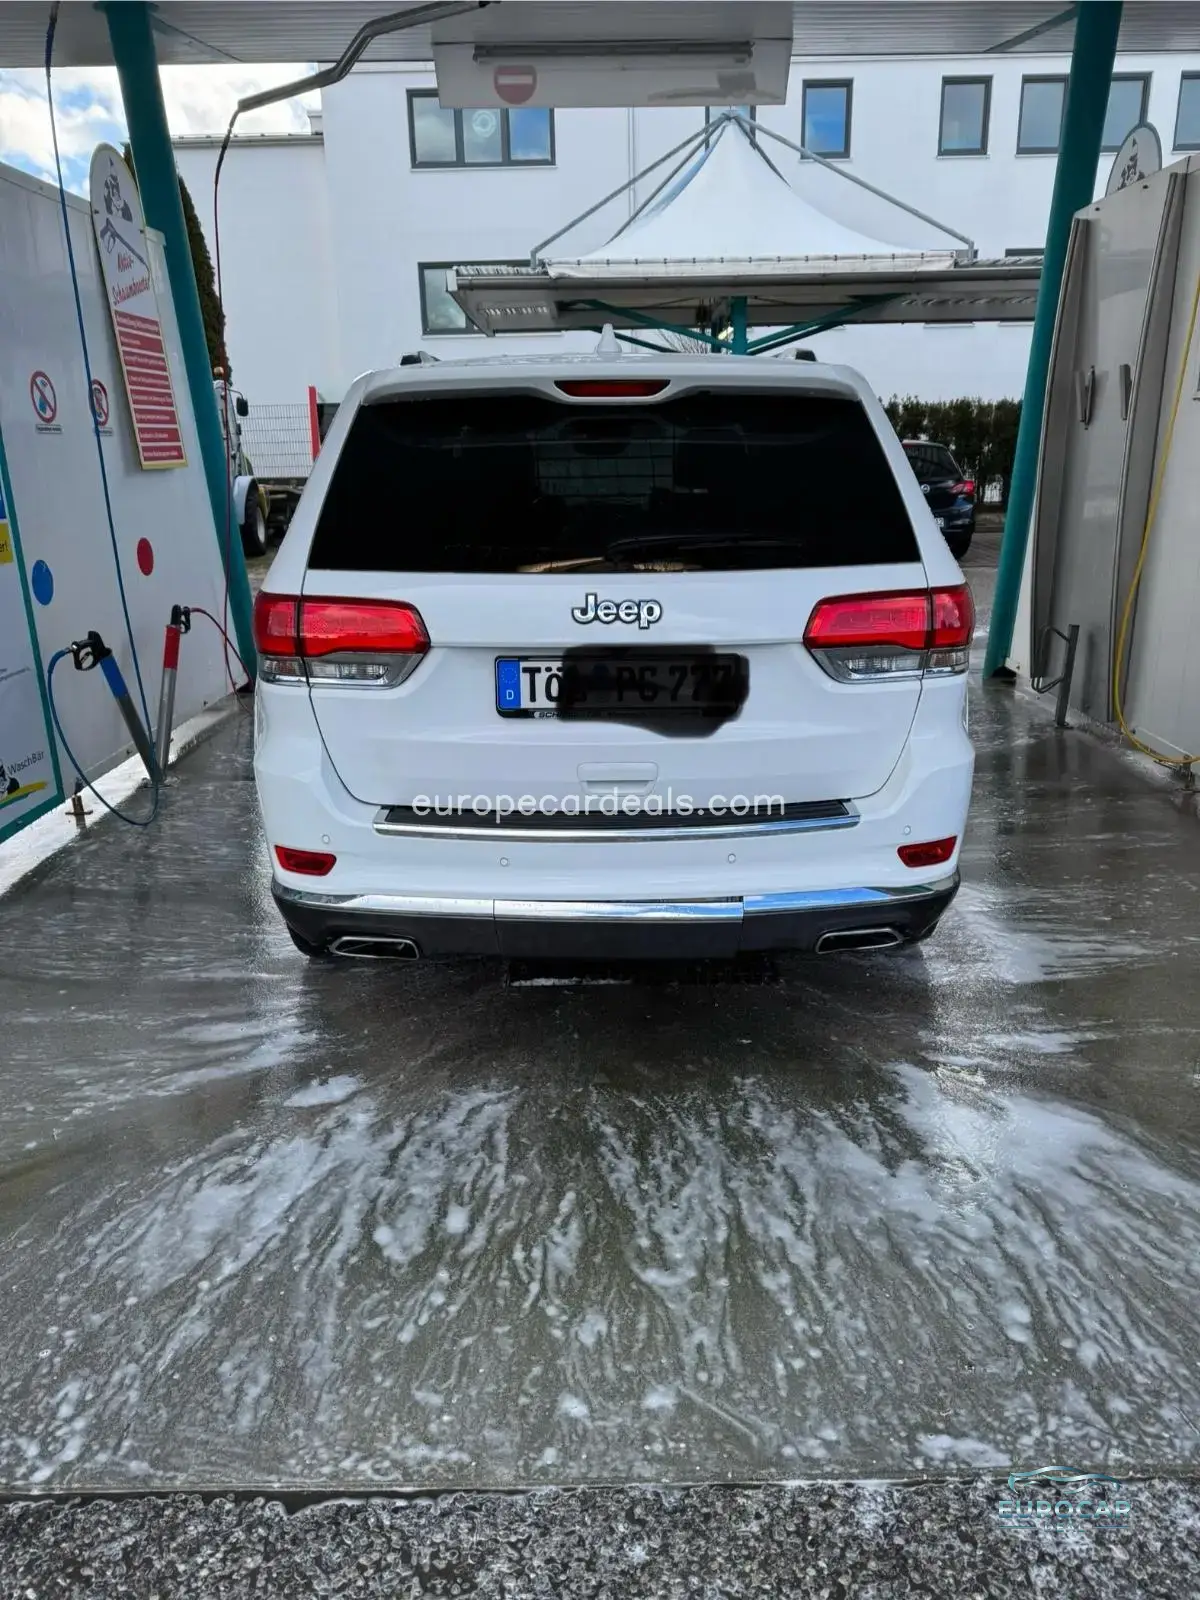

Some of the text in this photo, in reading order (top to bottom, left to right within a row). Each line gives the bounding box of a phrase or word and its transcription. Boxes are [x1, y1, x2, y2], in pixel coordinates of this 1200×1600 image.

[571, 592, 662, 629] Jeep
[506, 690, 514, 700] D
[7, 751, 44, 775] WaschBär
